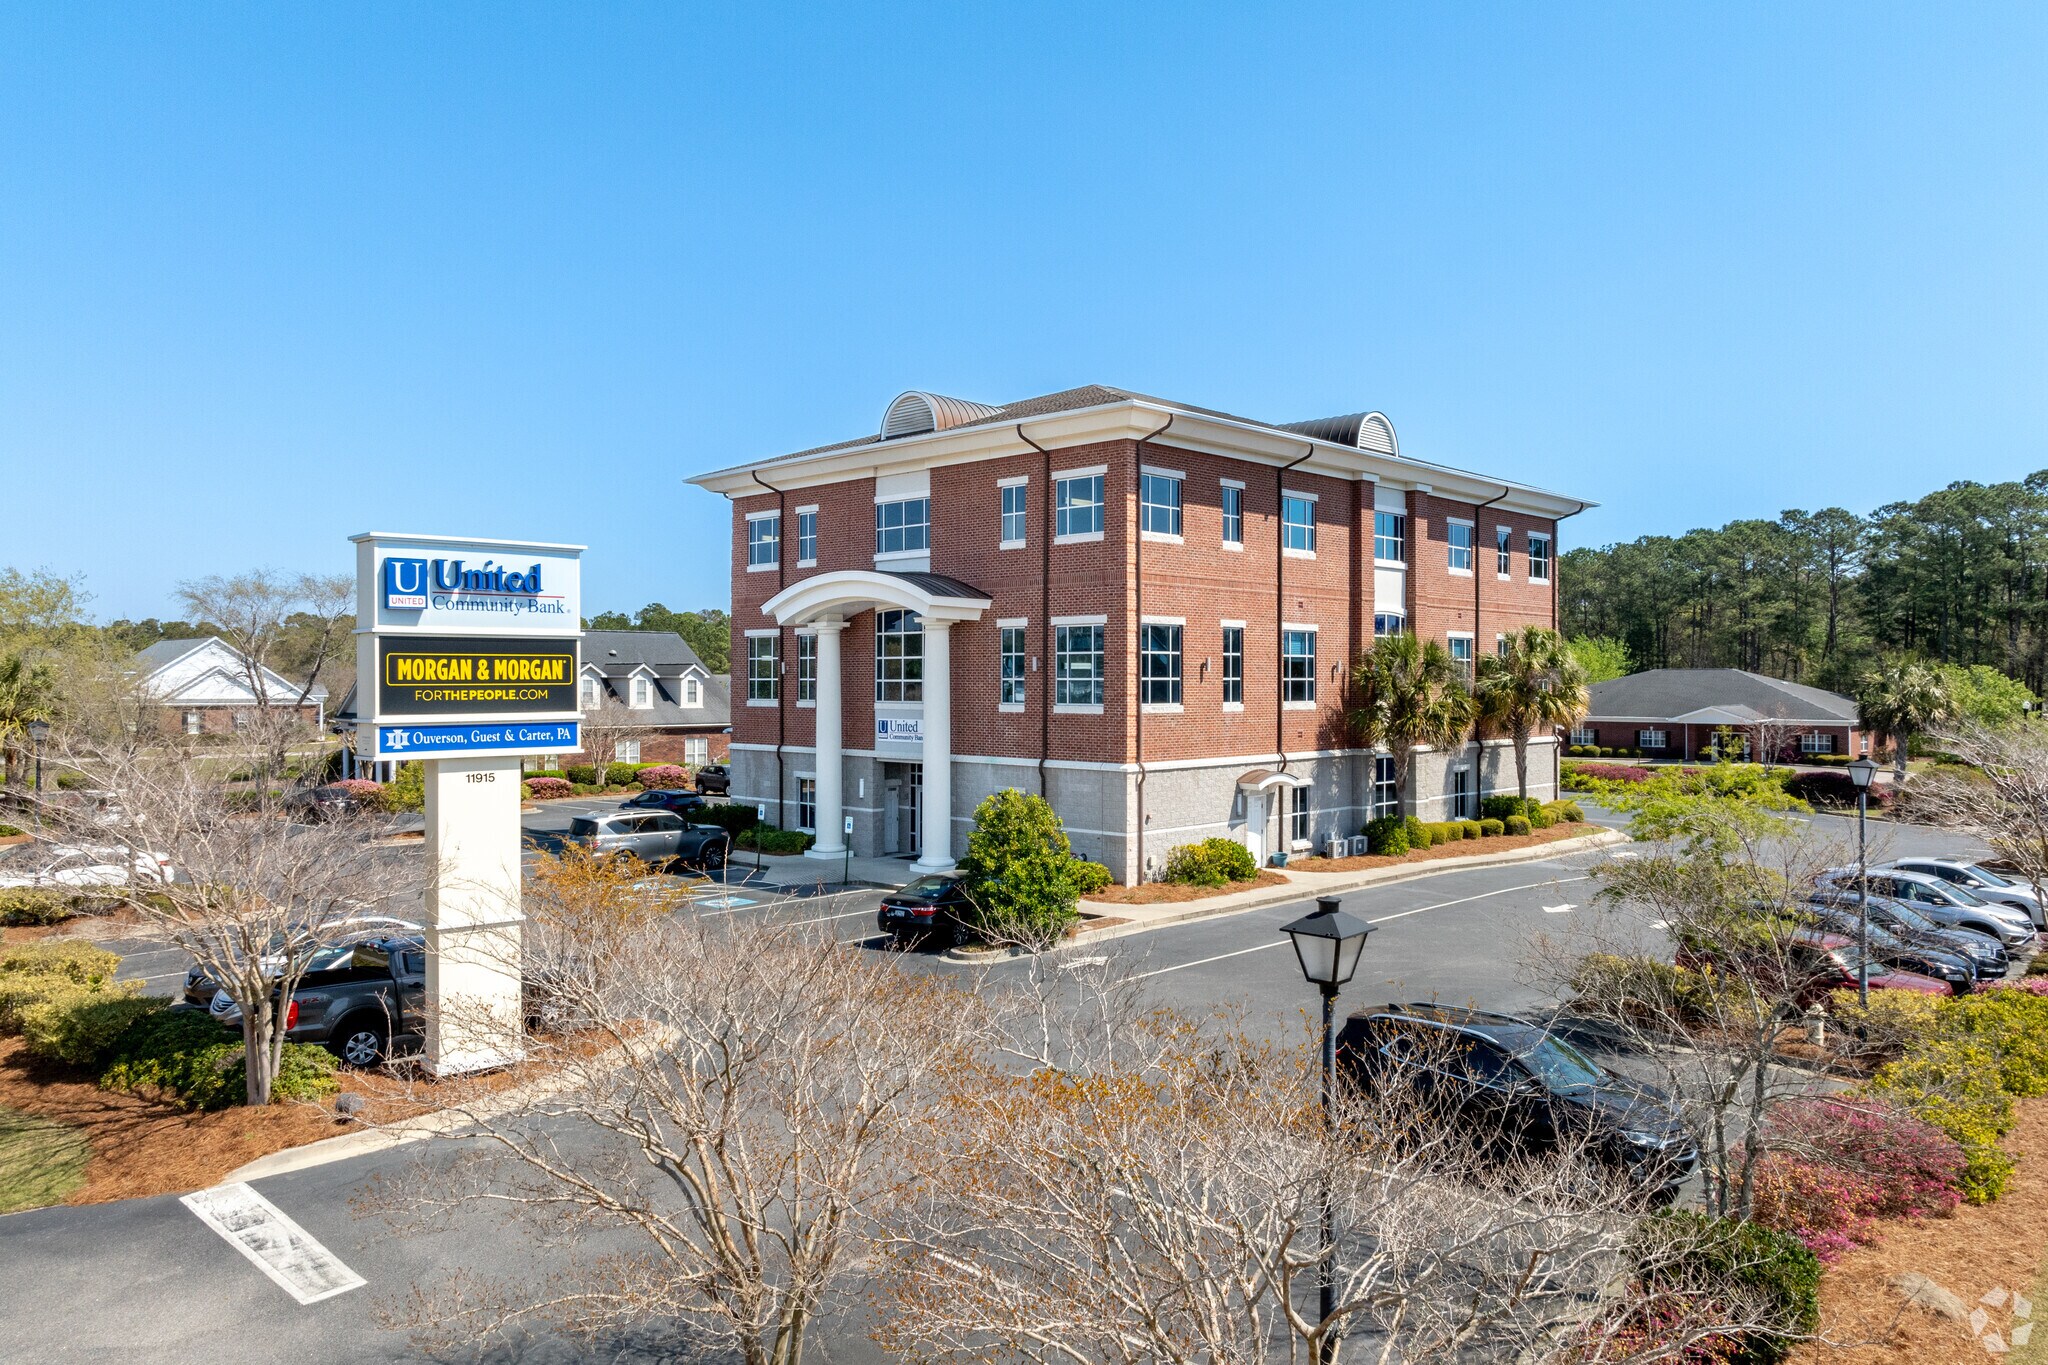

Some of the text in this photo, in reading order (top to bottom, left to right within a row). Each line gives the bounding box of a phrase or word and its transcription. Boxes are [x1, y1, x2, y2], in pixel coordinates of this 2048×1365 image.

[391, 561, 423, 592] U
[433, 559, 544, 593] United
[391, 597, 424, 605] UNITED
[432, 595, 564, 616] Community Bank
[397, 658, 563, 680] MORGAN & MORGAN
[415, 689, 548, 701] FORTHEPEOPLE.COM
[890, 720, 918, 732] United
[413, 727, 571, 744] Ouverson, Guest & Carter, PA
[889, 734, 914, 742] Community
[465, 773, 496, 783] 11915
